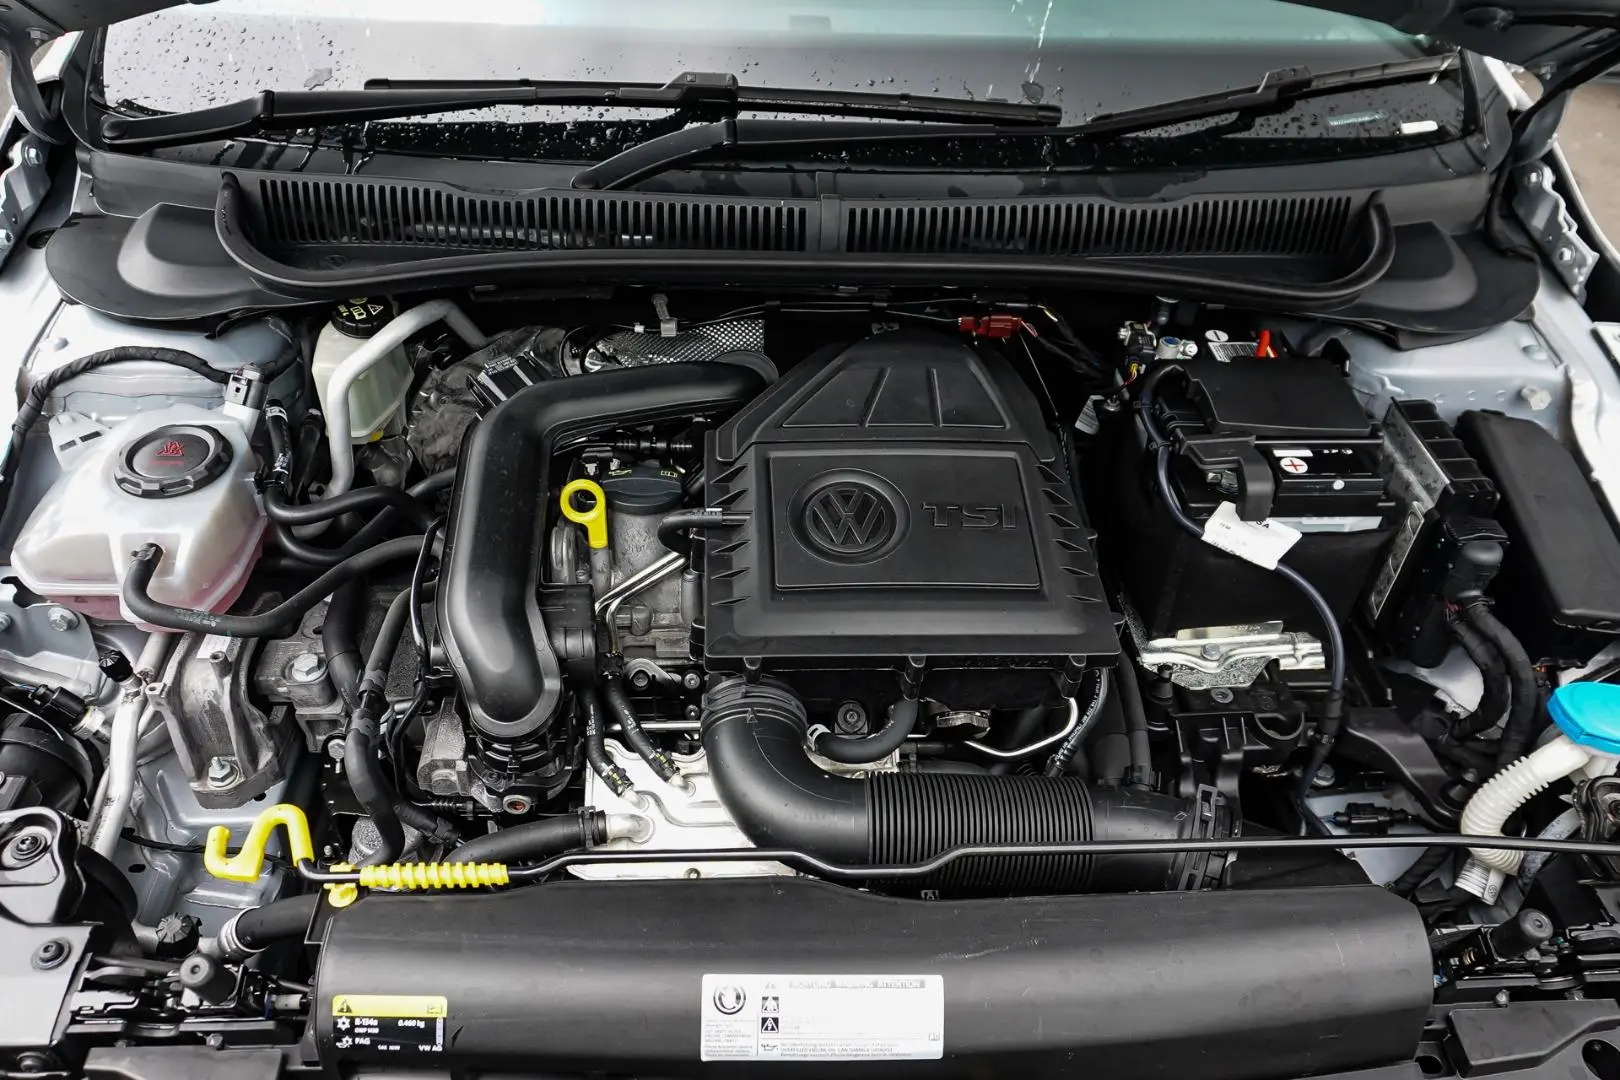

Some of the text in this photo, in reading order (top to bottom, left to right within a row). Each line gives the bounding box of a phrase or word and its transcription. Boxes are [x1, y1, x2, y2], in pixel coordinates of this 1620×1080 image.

[922, 502, 1022, 531] TSI
[354, 1037, 371, 1045] PAG
[418, 1044, 432, 1052] VW
